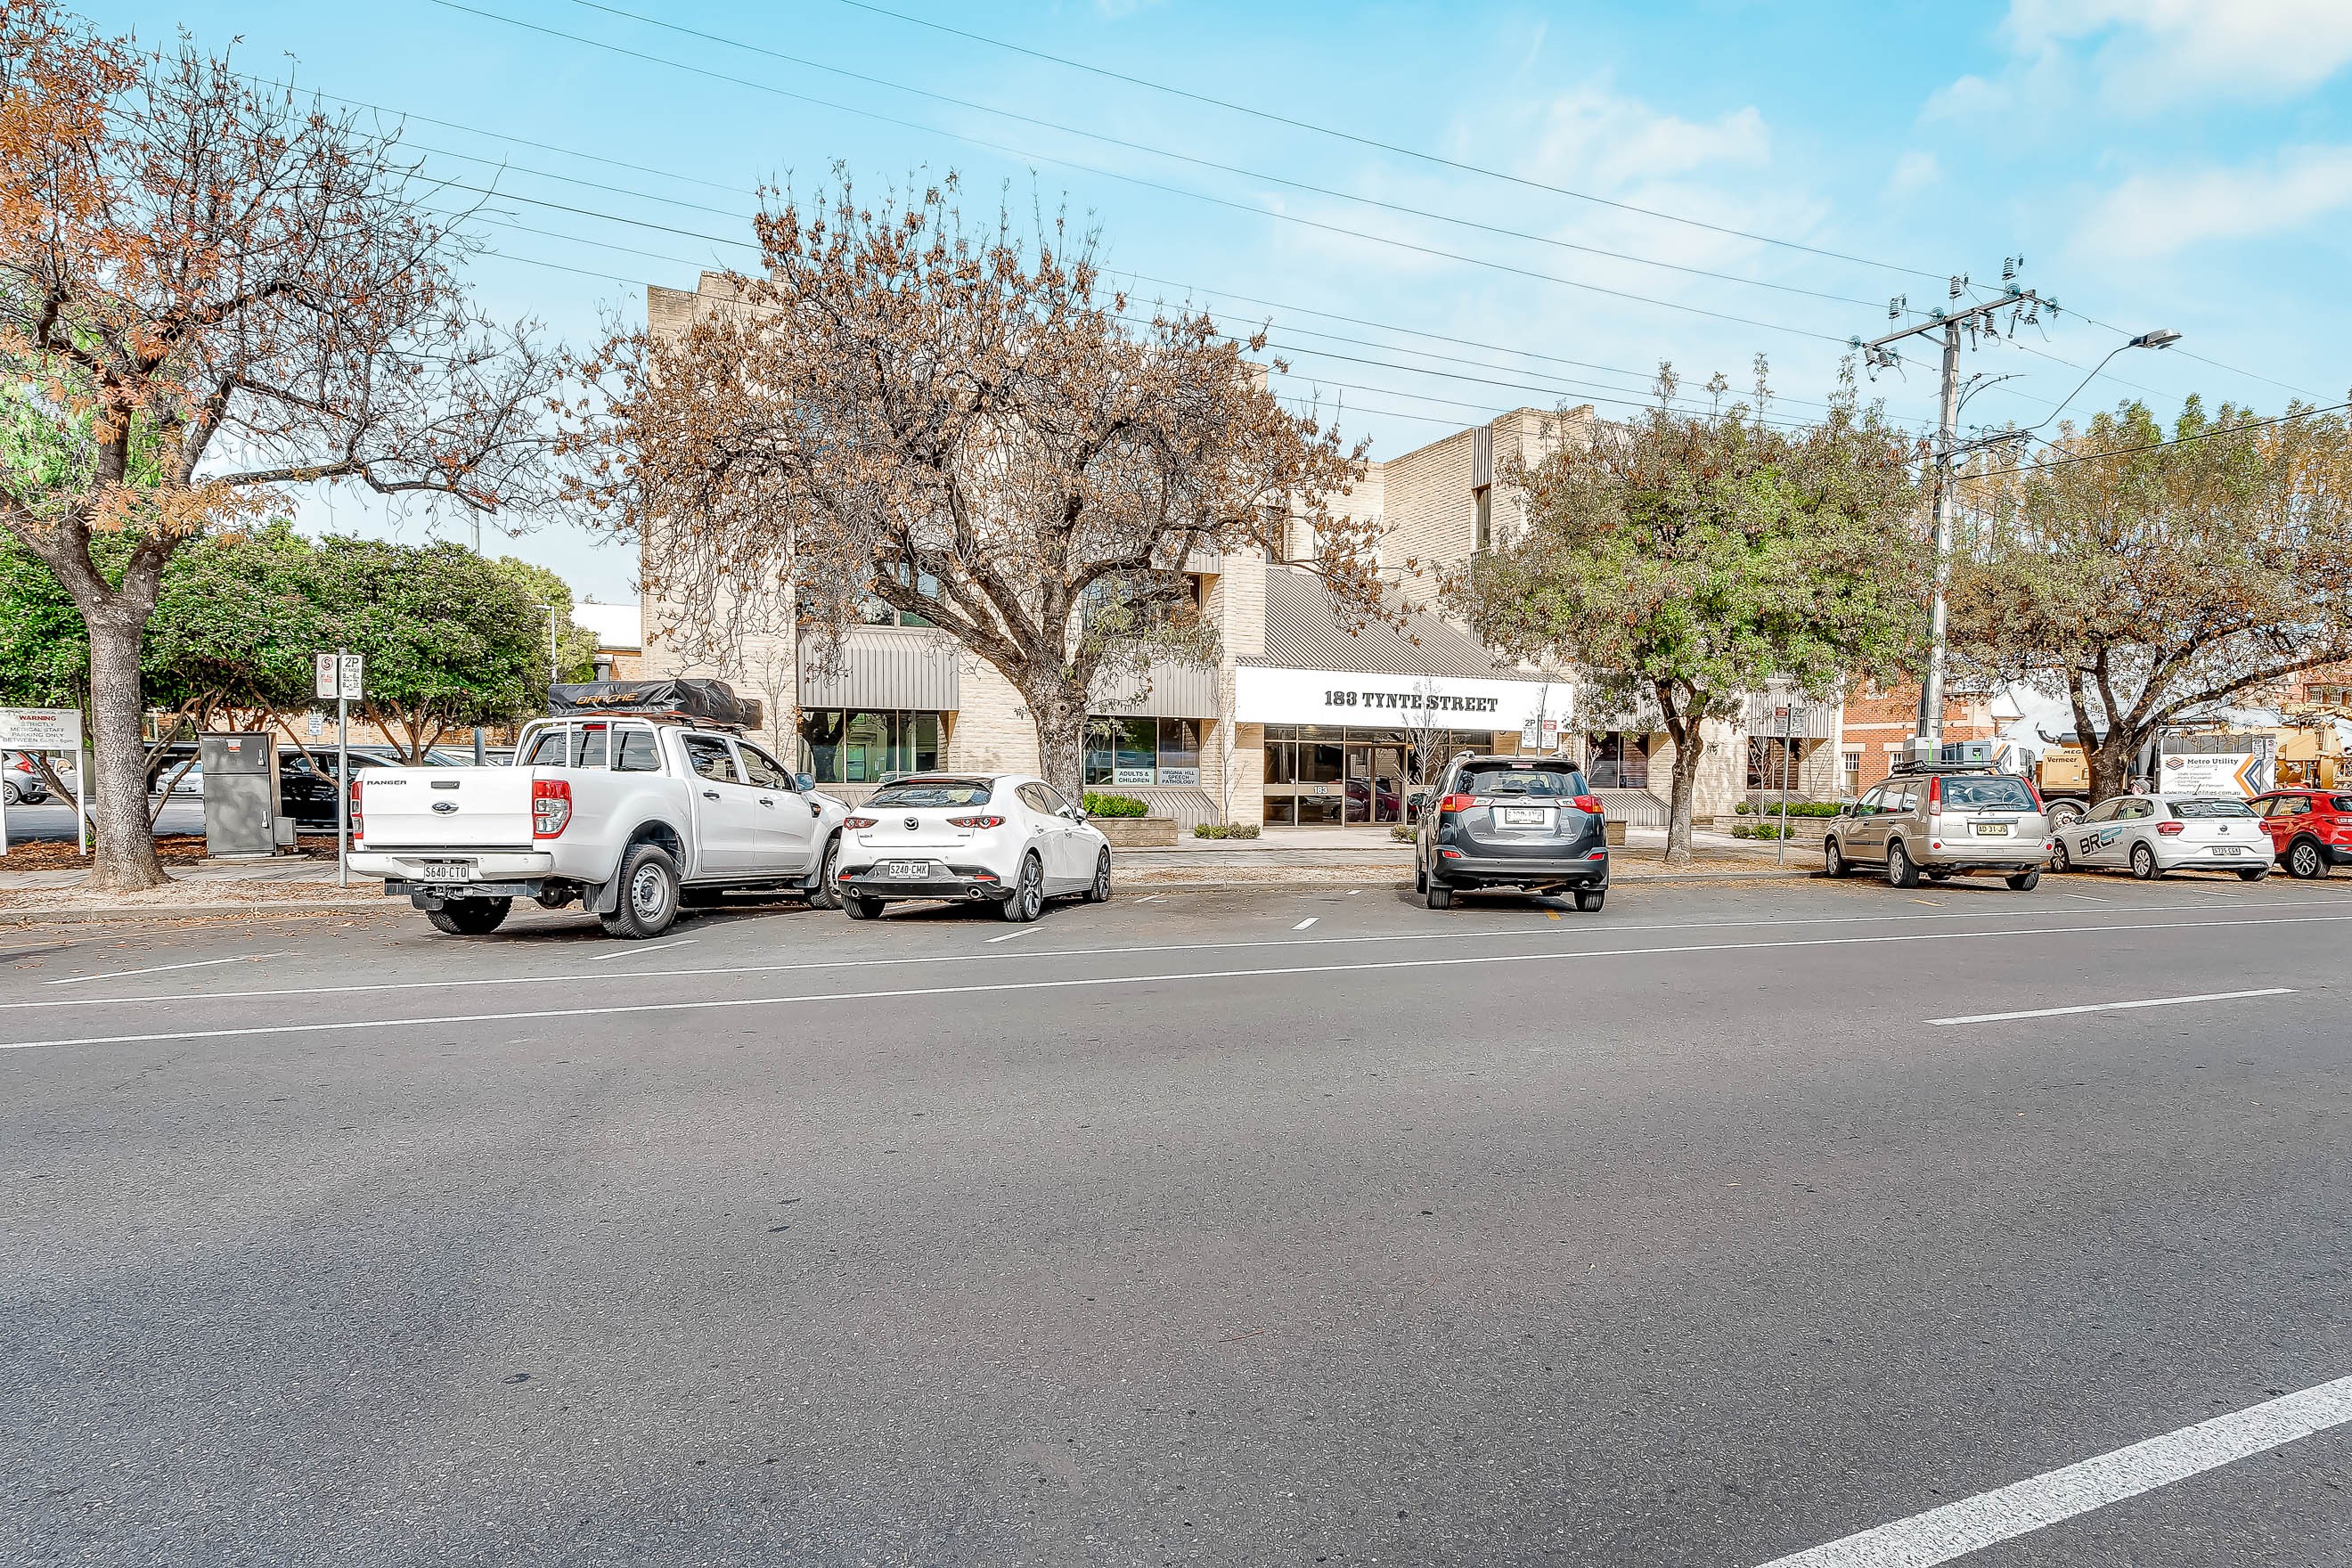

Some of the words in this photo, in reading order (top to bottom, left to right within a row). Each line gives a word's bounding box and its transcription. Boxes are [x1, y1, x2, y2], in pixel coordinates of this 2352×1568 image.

[345, 657, 359, 667] 2P
[1325, 690, 1358, 706] 183
[1362, 692, 1422, 709] TYNTE
[1425, 695, 1498, 712] STREET
[1524, 719, 1536, 727] 2P
[2212, 757, 2239, 765] Utility
[1313, 786, 1327, 795] 183
